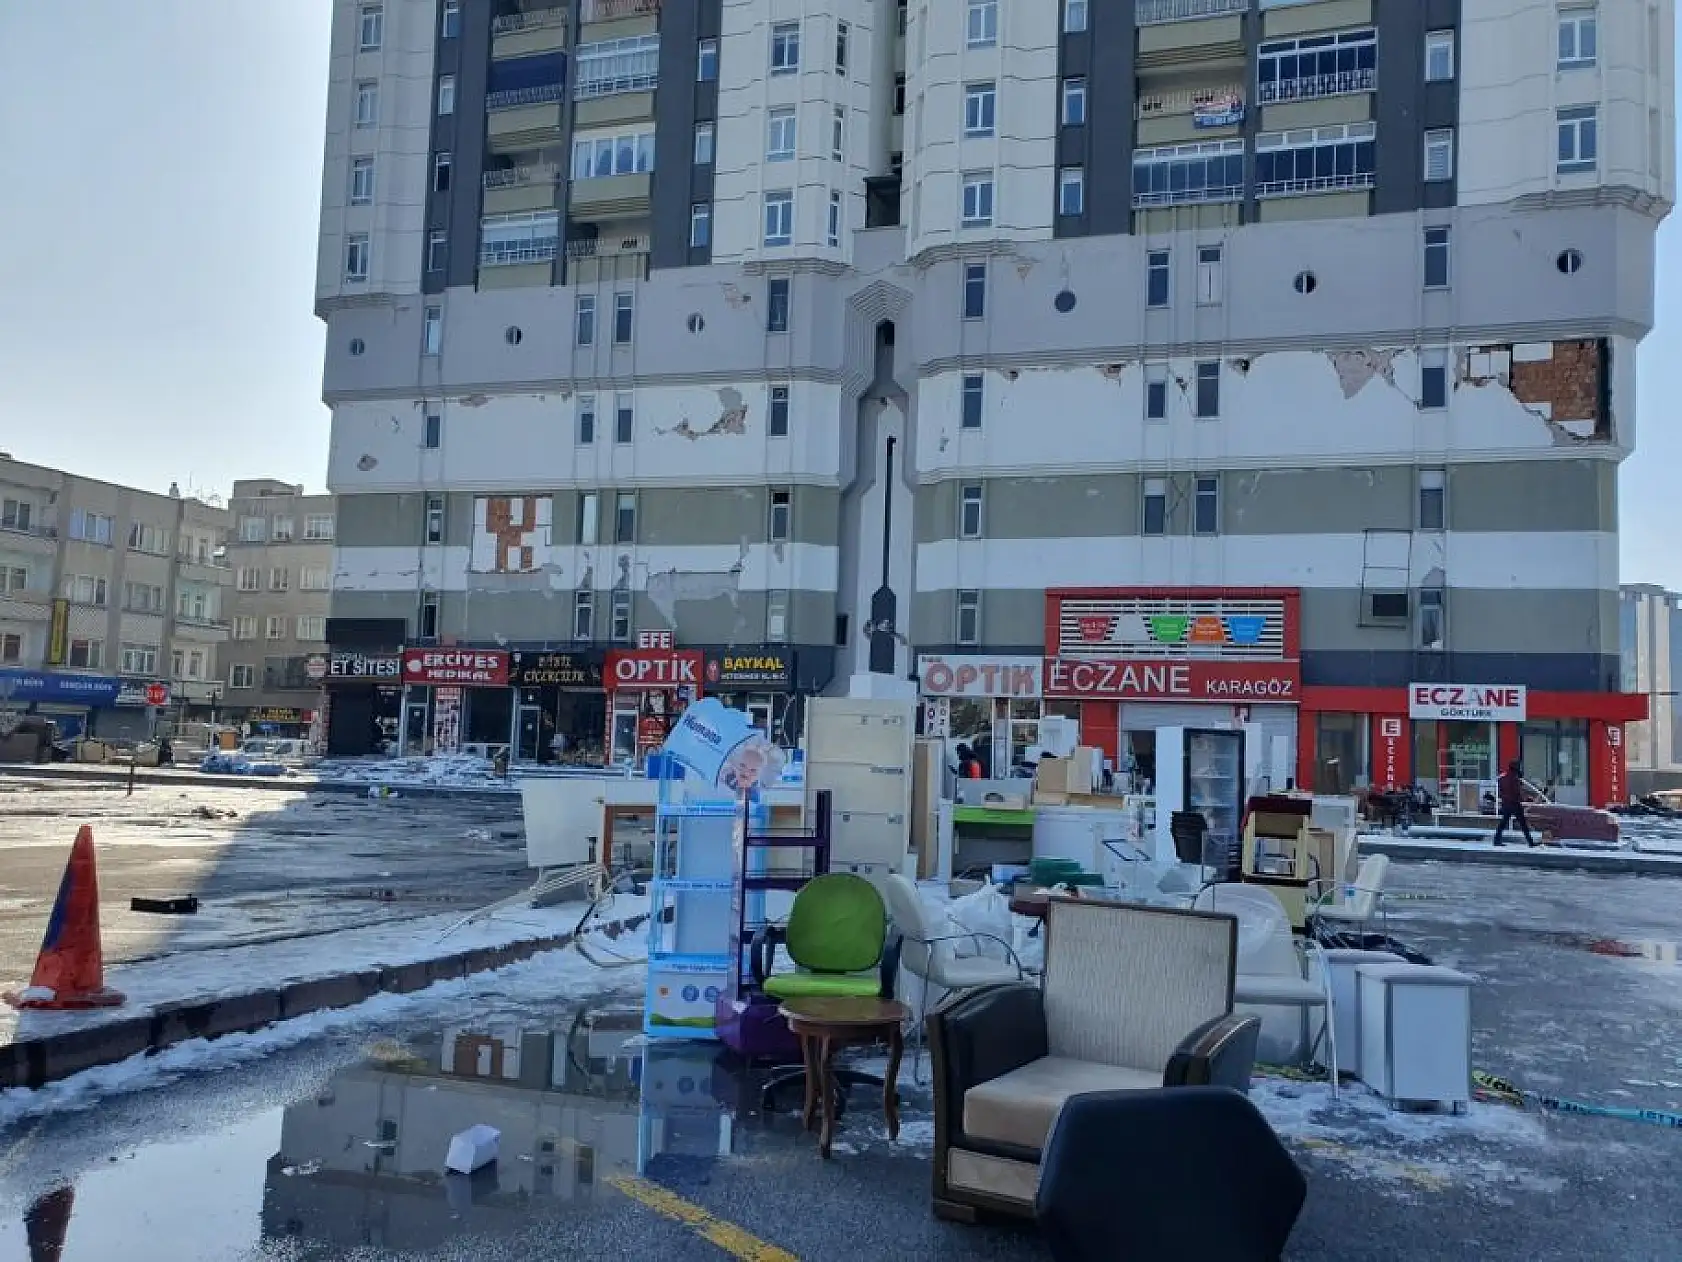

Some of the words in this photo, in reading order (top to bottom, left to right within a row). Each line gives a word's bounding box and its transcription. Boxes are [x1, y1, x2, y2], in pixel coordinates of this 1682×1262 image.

[639, 632, 671, 649] EFE
[331, 660, 348, 675] ET
[616, 652, 697, 681] OPTİK
[724, 656, 785, 670] BAYKAL
[1049, 665, 1191, 693] ECZANE
[1206, 678, 1293, 695] KARAGÖZ
[1415, 687, 1520, 707] ECZANE
